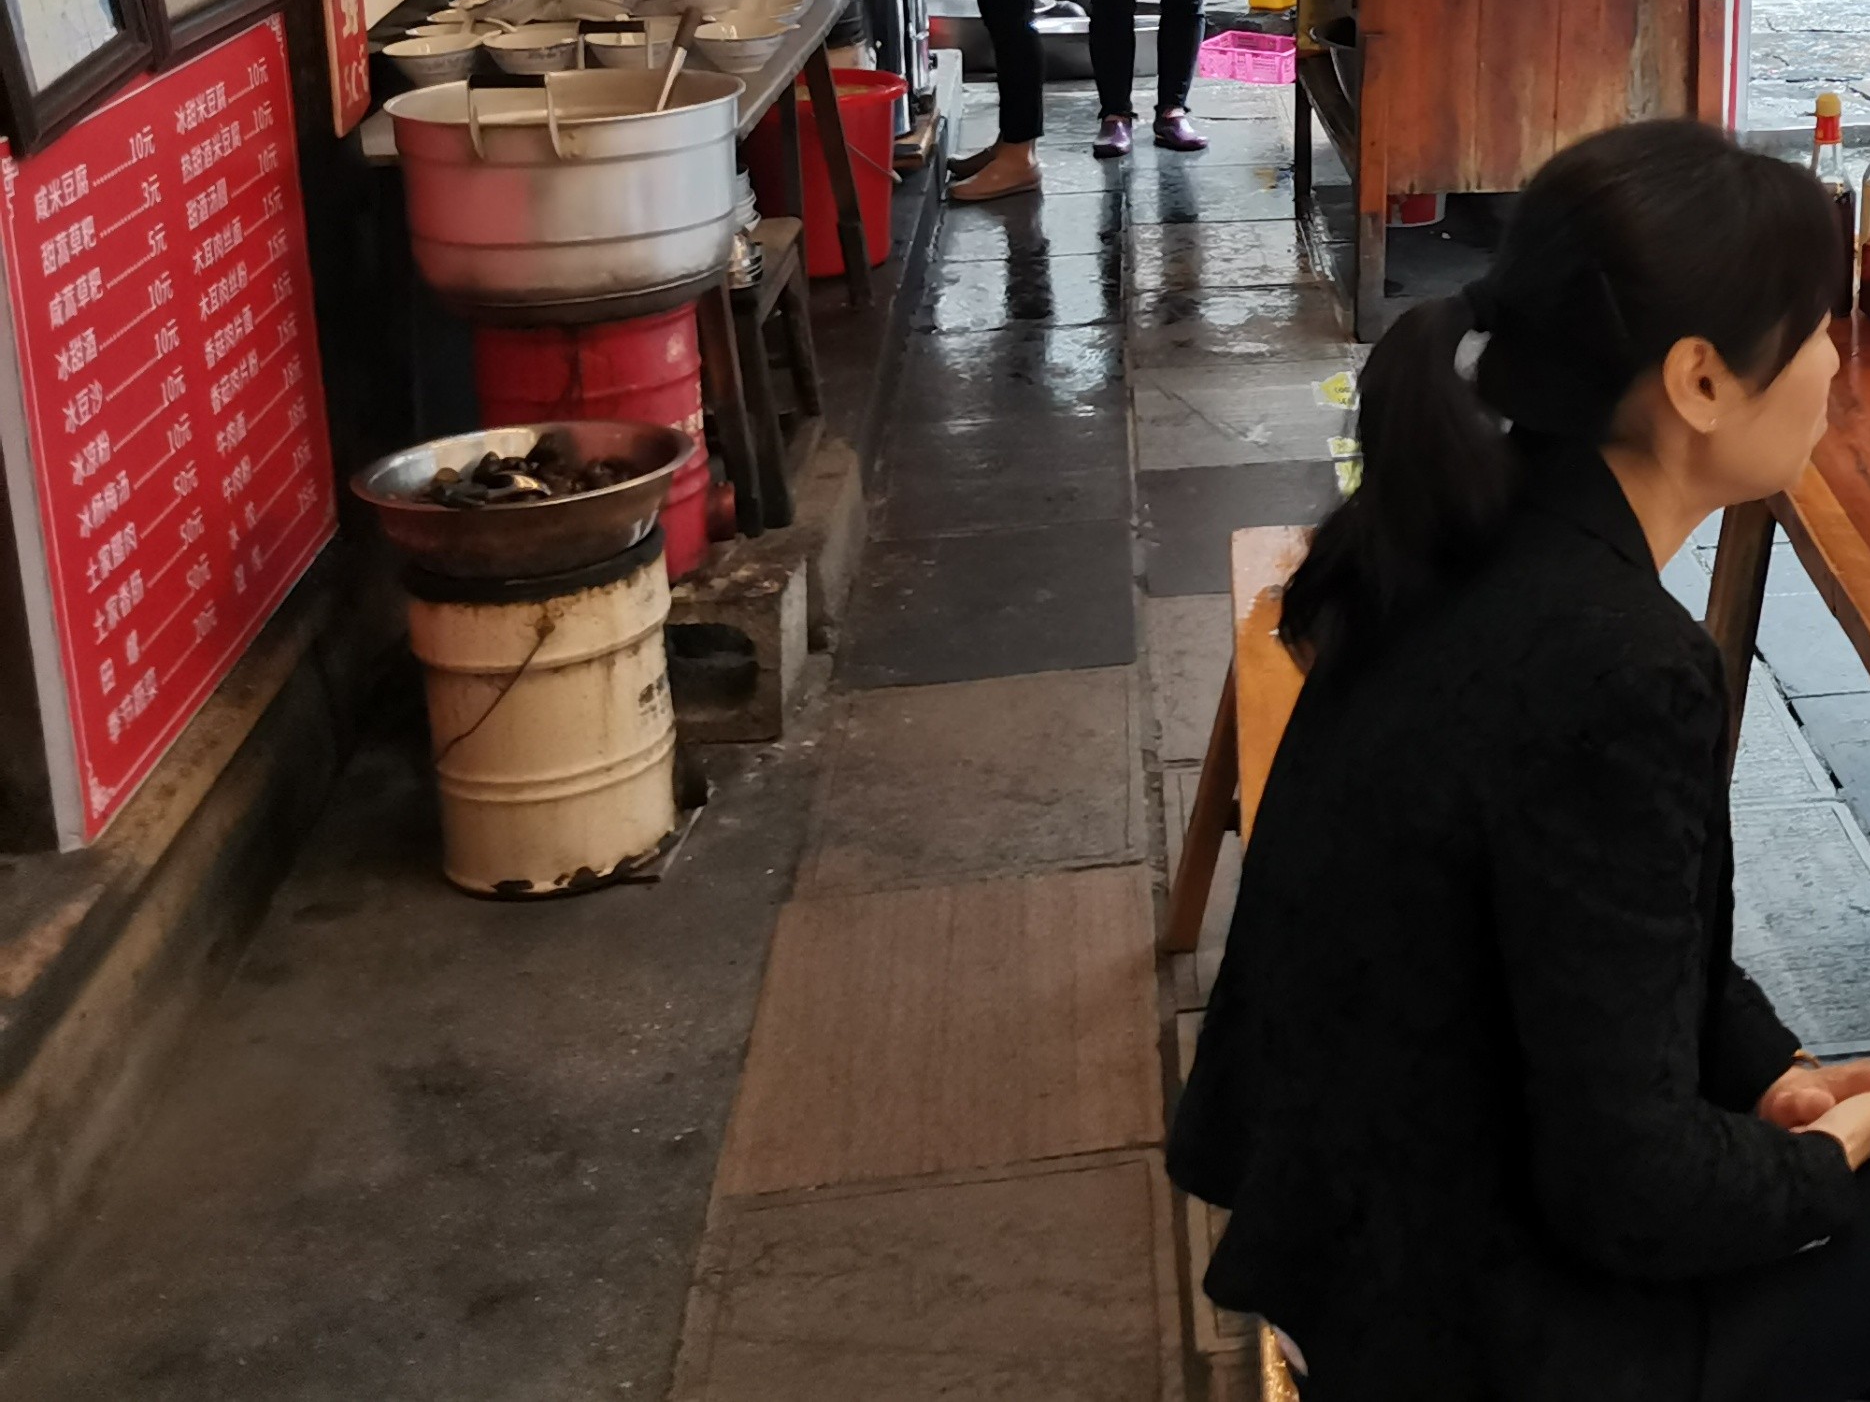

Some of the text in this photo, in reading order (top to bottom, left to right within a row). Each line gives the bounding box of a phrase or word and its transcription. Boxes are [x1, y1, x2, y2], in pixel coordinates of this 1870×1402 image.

[246, 56, 269, 90] 10元
[33, 124, 155, 221] 咸米豆腐 10元
[54, 270, 174, 380] 冰甜酒 10元
[62, 317, 180, 433] 冰豆沙 10元
[160, 364, 186, 409] 10元
